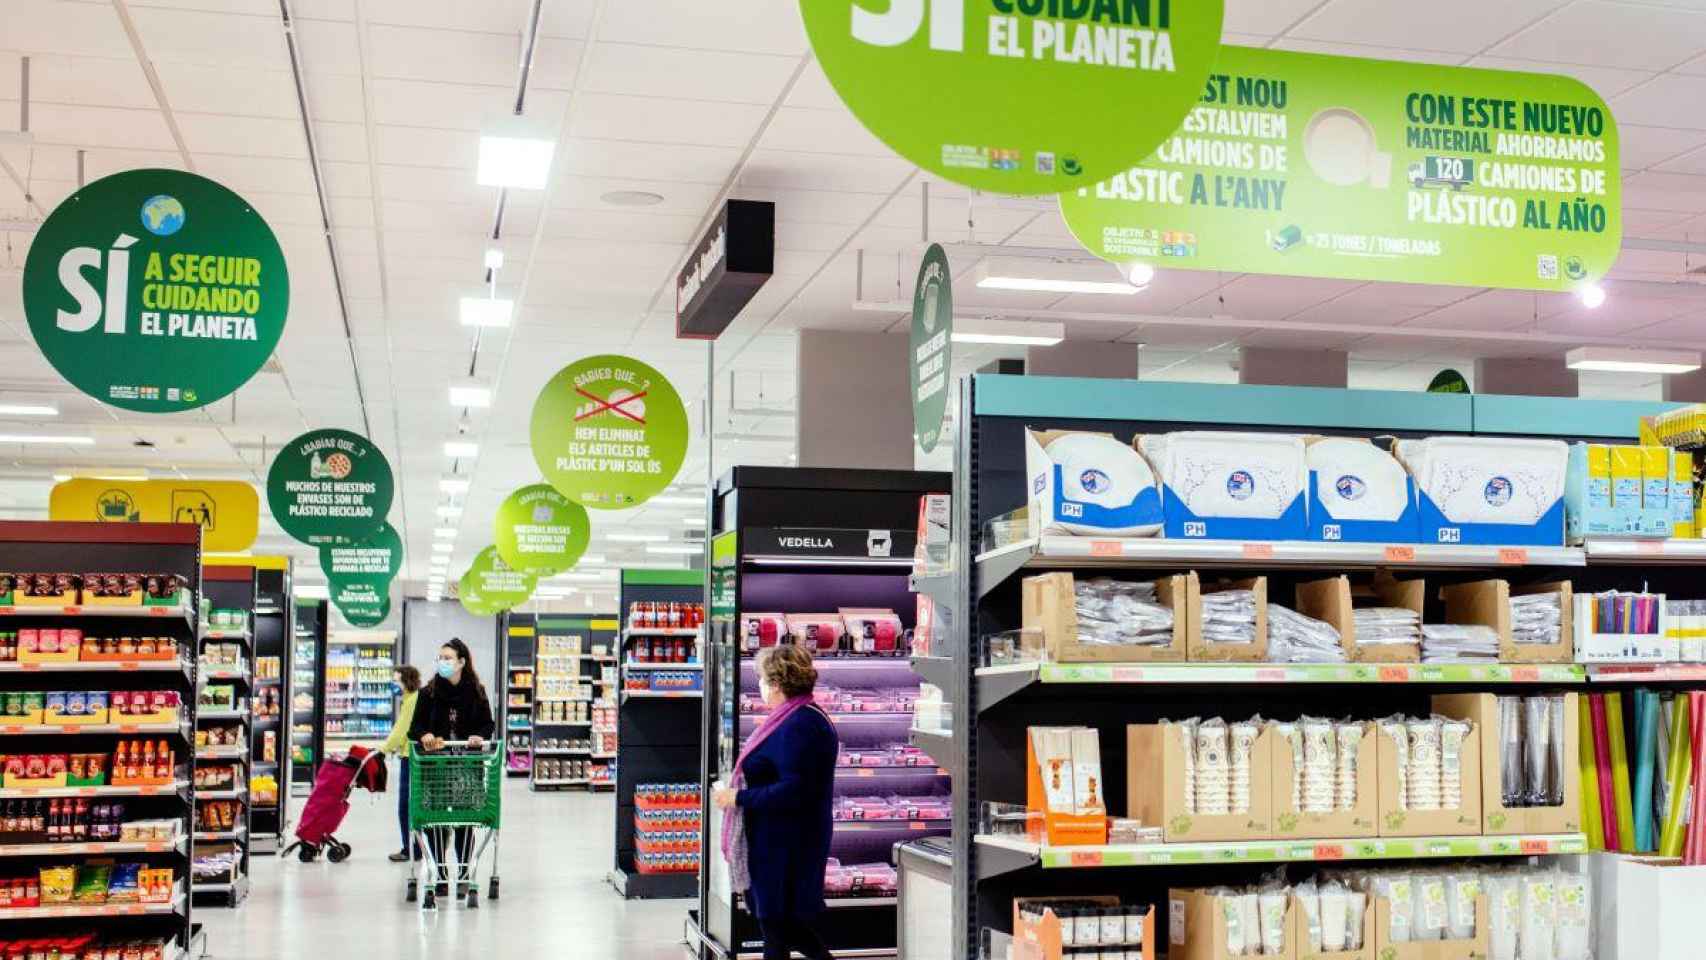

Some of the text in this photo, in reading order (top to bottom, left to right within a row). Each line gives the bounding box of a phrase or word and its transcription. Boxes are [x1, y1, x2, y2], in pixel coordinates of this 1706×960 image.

[988, 15, 1025, 57] EL
[1033, 19, 1176, 72] PLANETA
[1236, 77, 1287, 109] NOU
[1406, 93, 1604, 137] CON ESTE NUEVO
[1406, 126, 1605, 162] MATERIAL AHORRAMOS
[1259, 144, 1288, 172] DE
[1436, 158, 1464, 179] 120
[1479, 162, 1606, 195] CAMIONES DE
[1190, 174, 1208, 205] A
[1215, 175, 1287, 211] L'ANY
[1407, 188, 1606, 233] PLÁSTICO AL AÑO
[144, 252, 261, 286] A SEGUIR
[56, 233, 140, 334] SÍ
[143, 283, 260, 315] CUIDANDO
[141, 312, 258, 340] EL PLANETA
[576, 427, 645, 442] HEM ELIMINAT
[569, 441, 650, 458] ELS ARTICLES DE
[626, 459, 645, 473] SOL
[285, 481, 376, 493] MUCHOS DE NUESTROS
[296, 493, 364, 505] ENVASES SON DE
[329, 506, 374, 517] RECICLADO
[1063, 504, 1081, 516] PH
[1186, 523, 1205, 535] PH
[1324, 526, 1340, 538] PH
[1440, 529, 1459, 541] PH
[778, 536, 834, 549] VEDELLA
